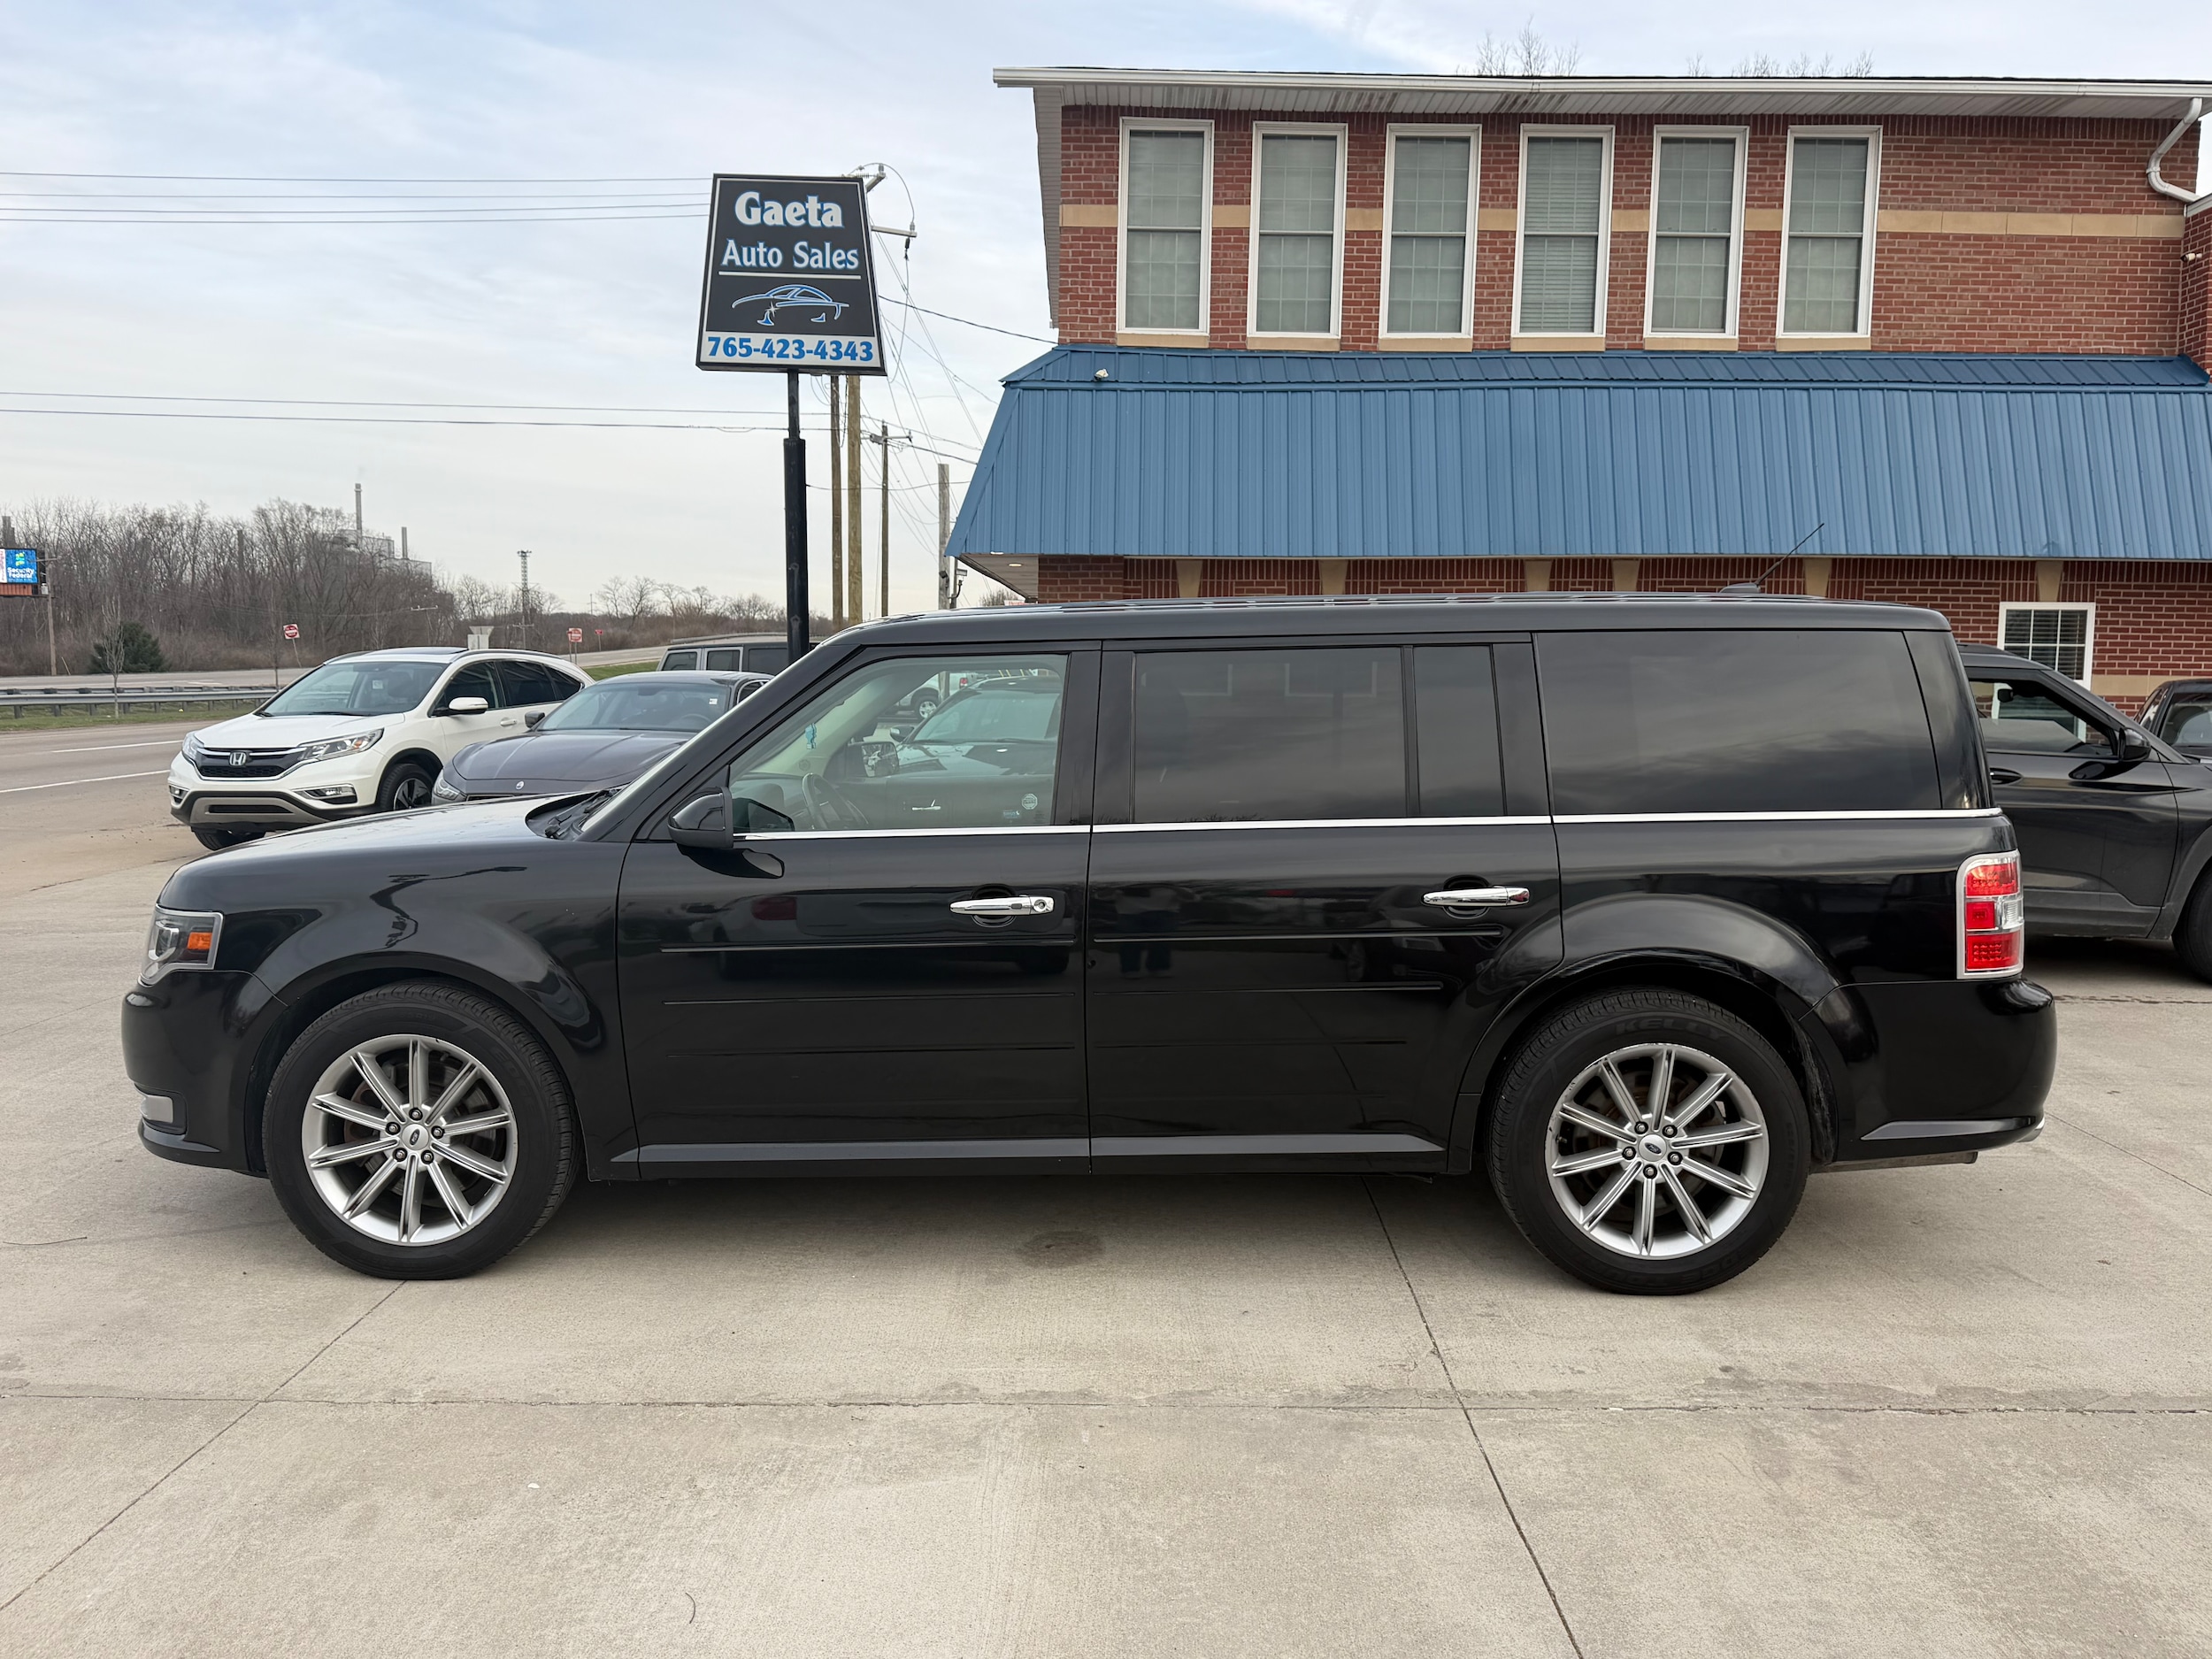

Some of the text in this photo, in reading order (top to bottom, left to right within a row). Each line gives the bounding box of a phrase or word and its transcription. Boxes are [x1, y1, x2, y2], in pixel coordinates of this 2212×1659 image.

[735, 191, 843, 227] Gaeta
[721, 238, 858, 269] Auto Sales
[708, 336, 873, 361] 765-423-4343
[1616, 1018, 1728, 1041] KELLY
